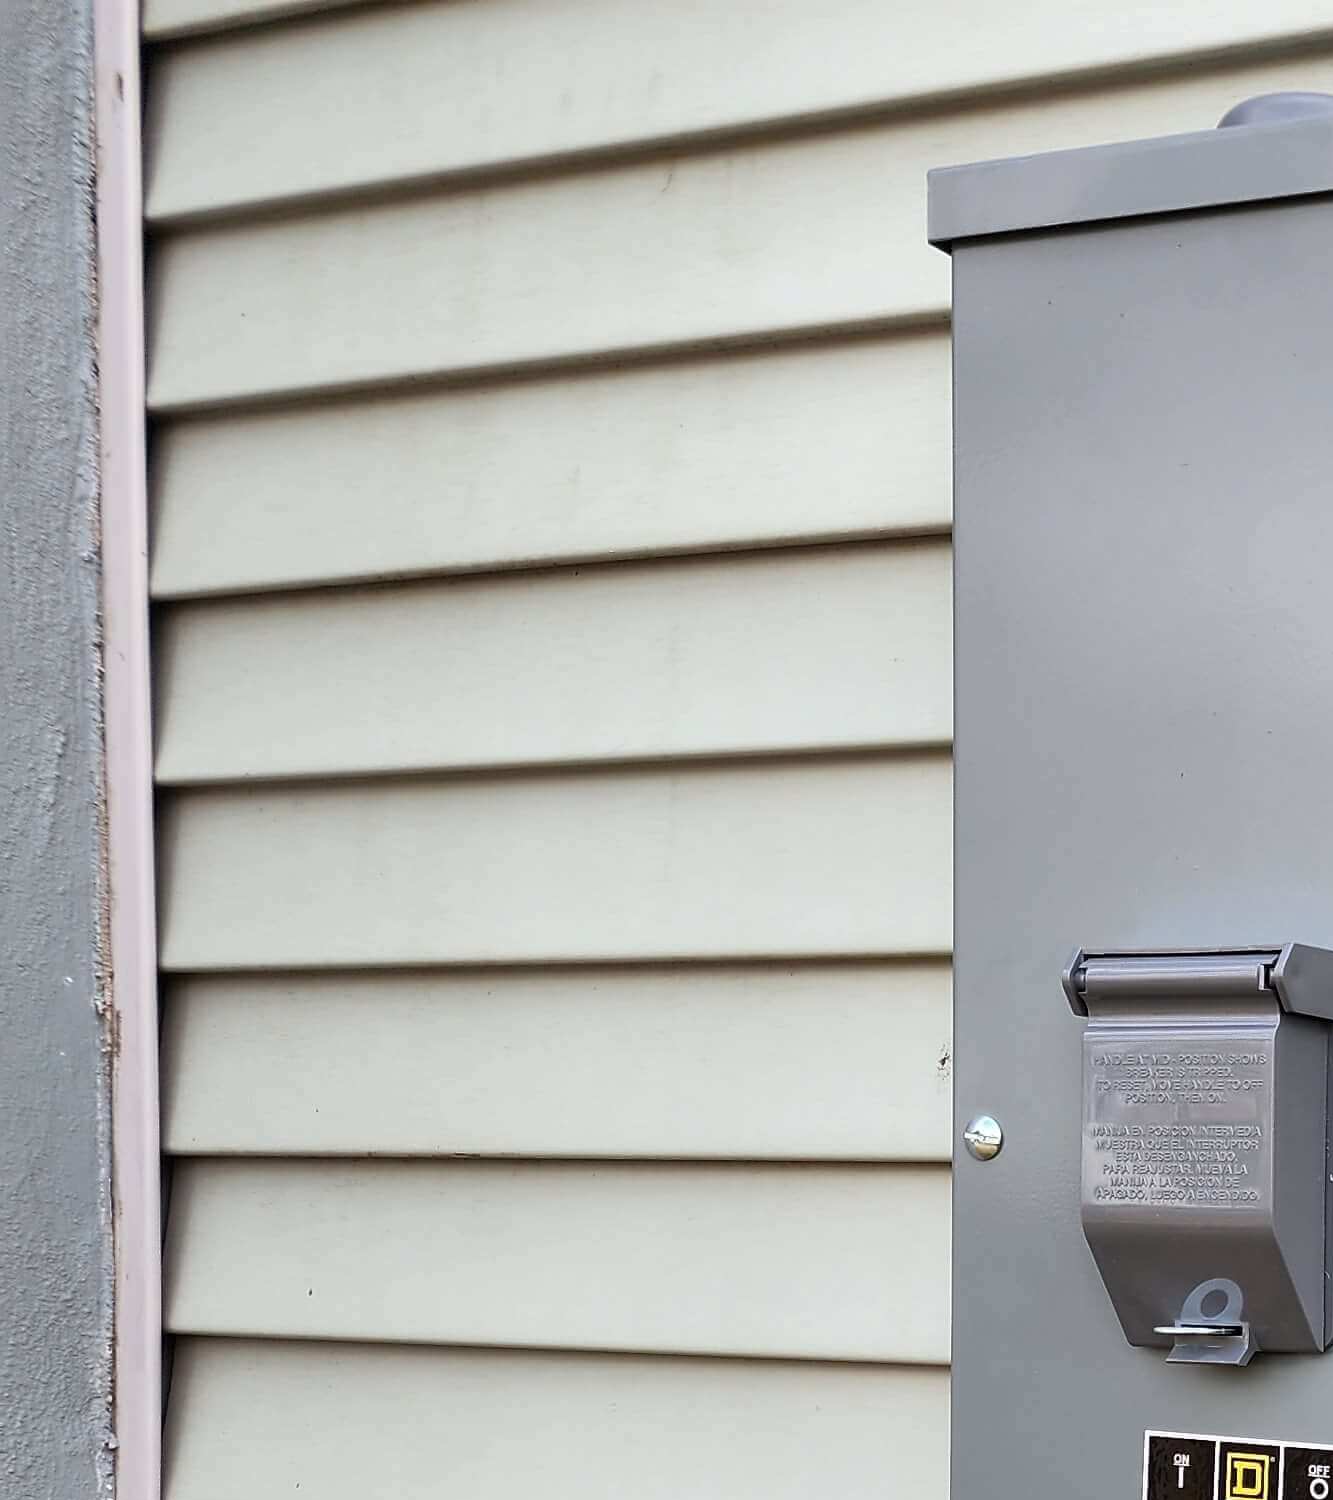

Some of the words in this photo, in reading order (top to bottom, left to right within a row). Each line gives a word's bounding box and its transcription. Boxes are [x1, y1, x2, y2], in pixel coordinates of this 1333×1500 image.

[1243, 1079, 1263, 1091] OFF
[1173, 1453, 1190, 1464] ON
[1308, 1464, 1330, 1476] OFF
